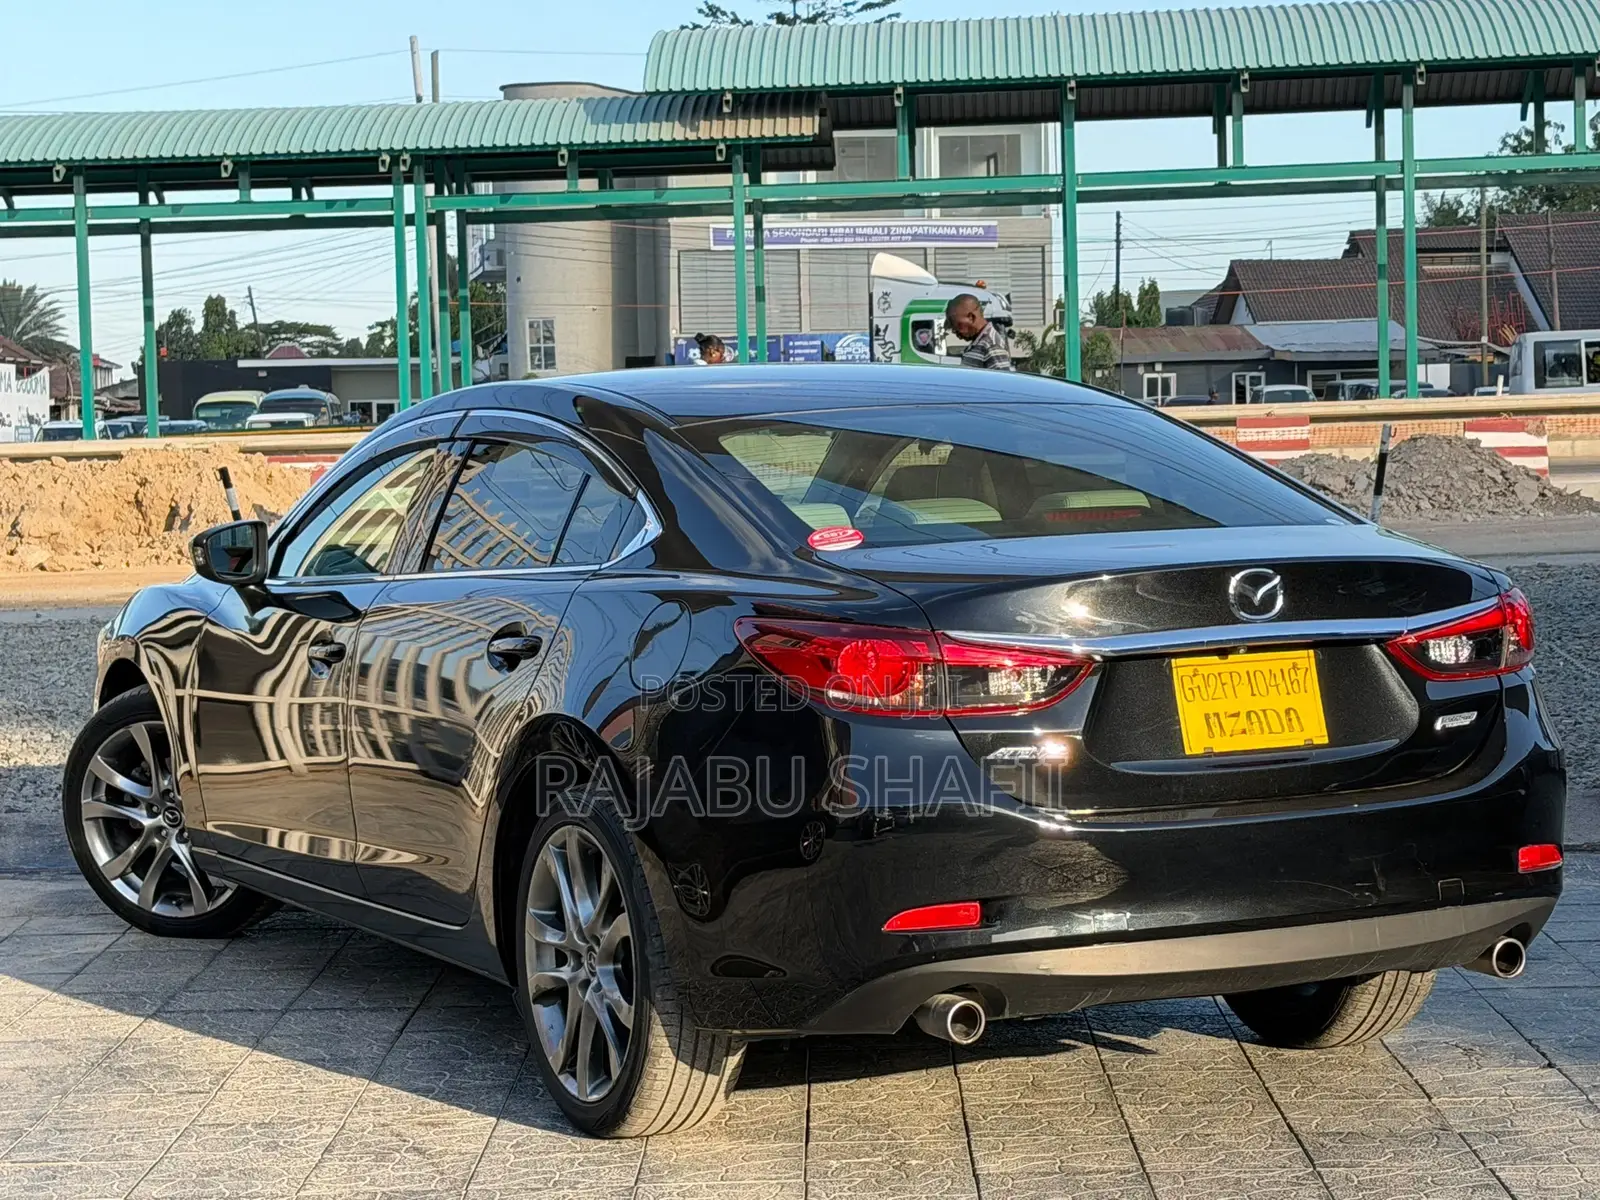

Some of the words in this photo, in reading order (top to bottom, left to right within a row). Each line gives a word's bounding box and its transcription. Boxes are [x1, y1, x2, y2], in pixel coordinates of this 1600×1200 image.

[890, 226, 957, 236] ZINAPATIKANA
[959, 226, 985, 236] HAPA
[835, 346, 870, 355] SPOR
